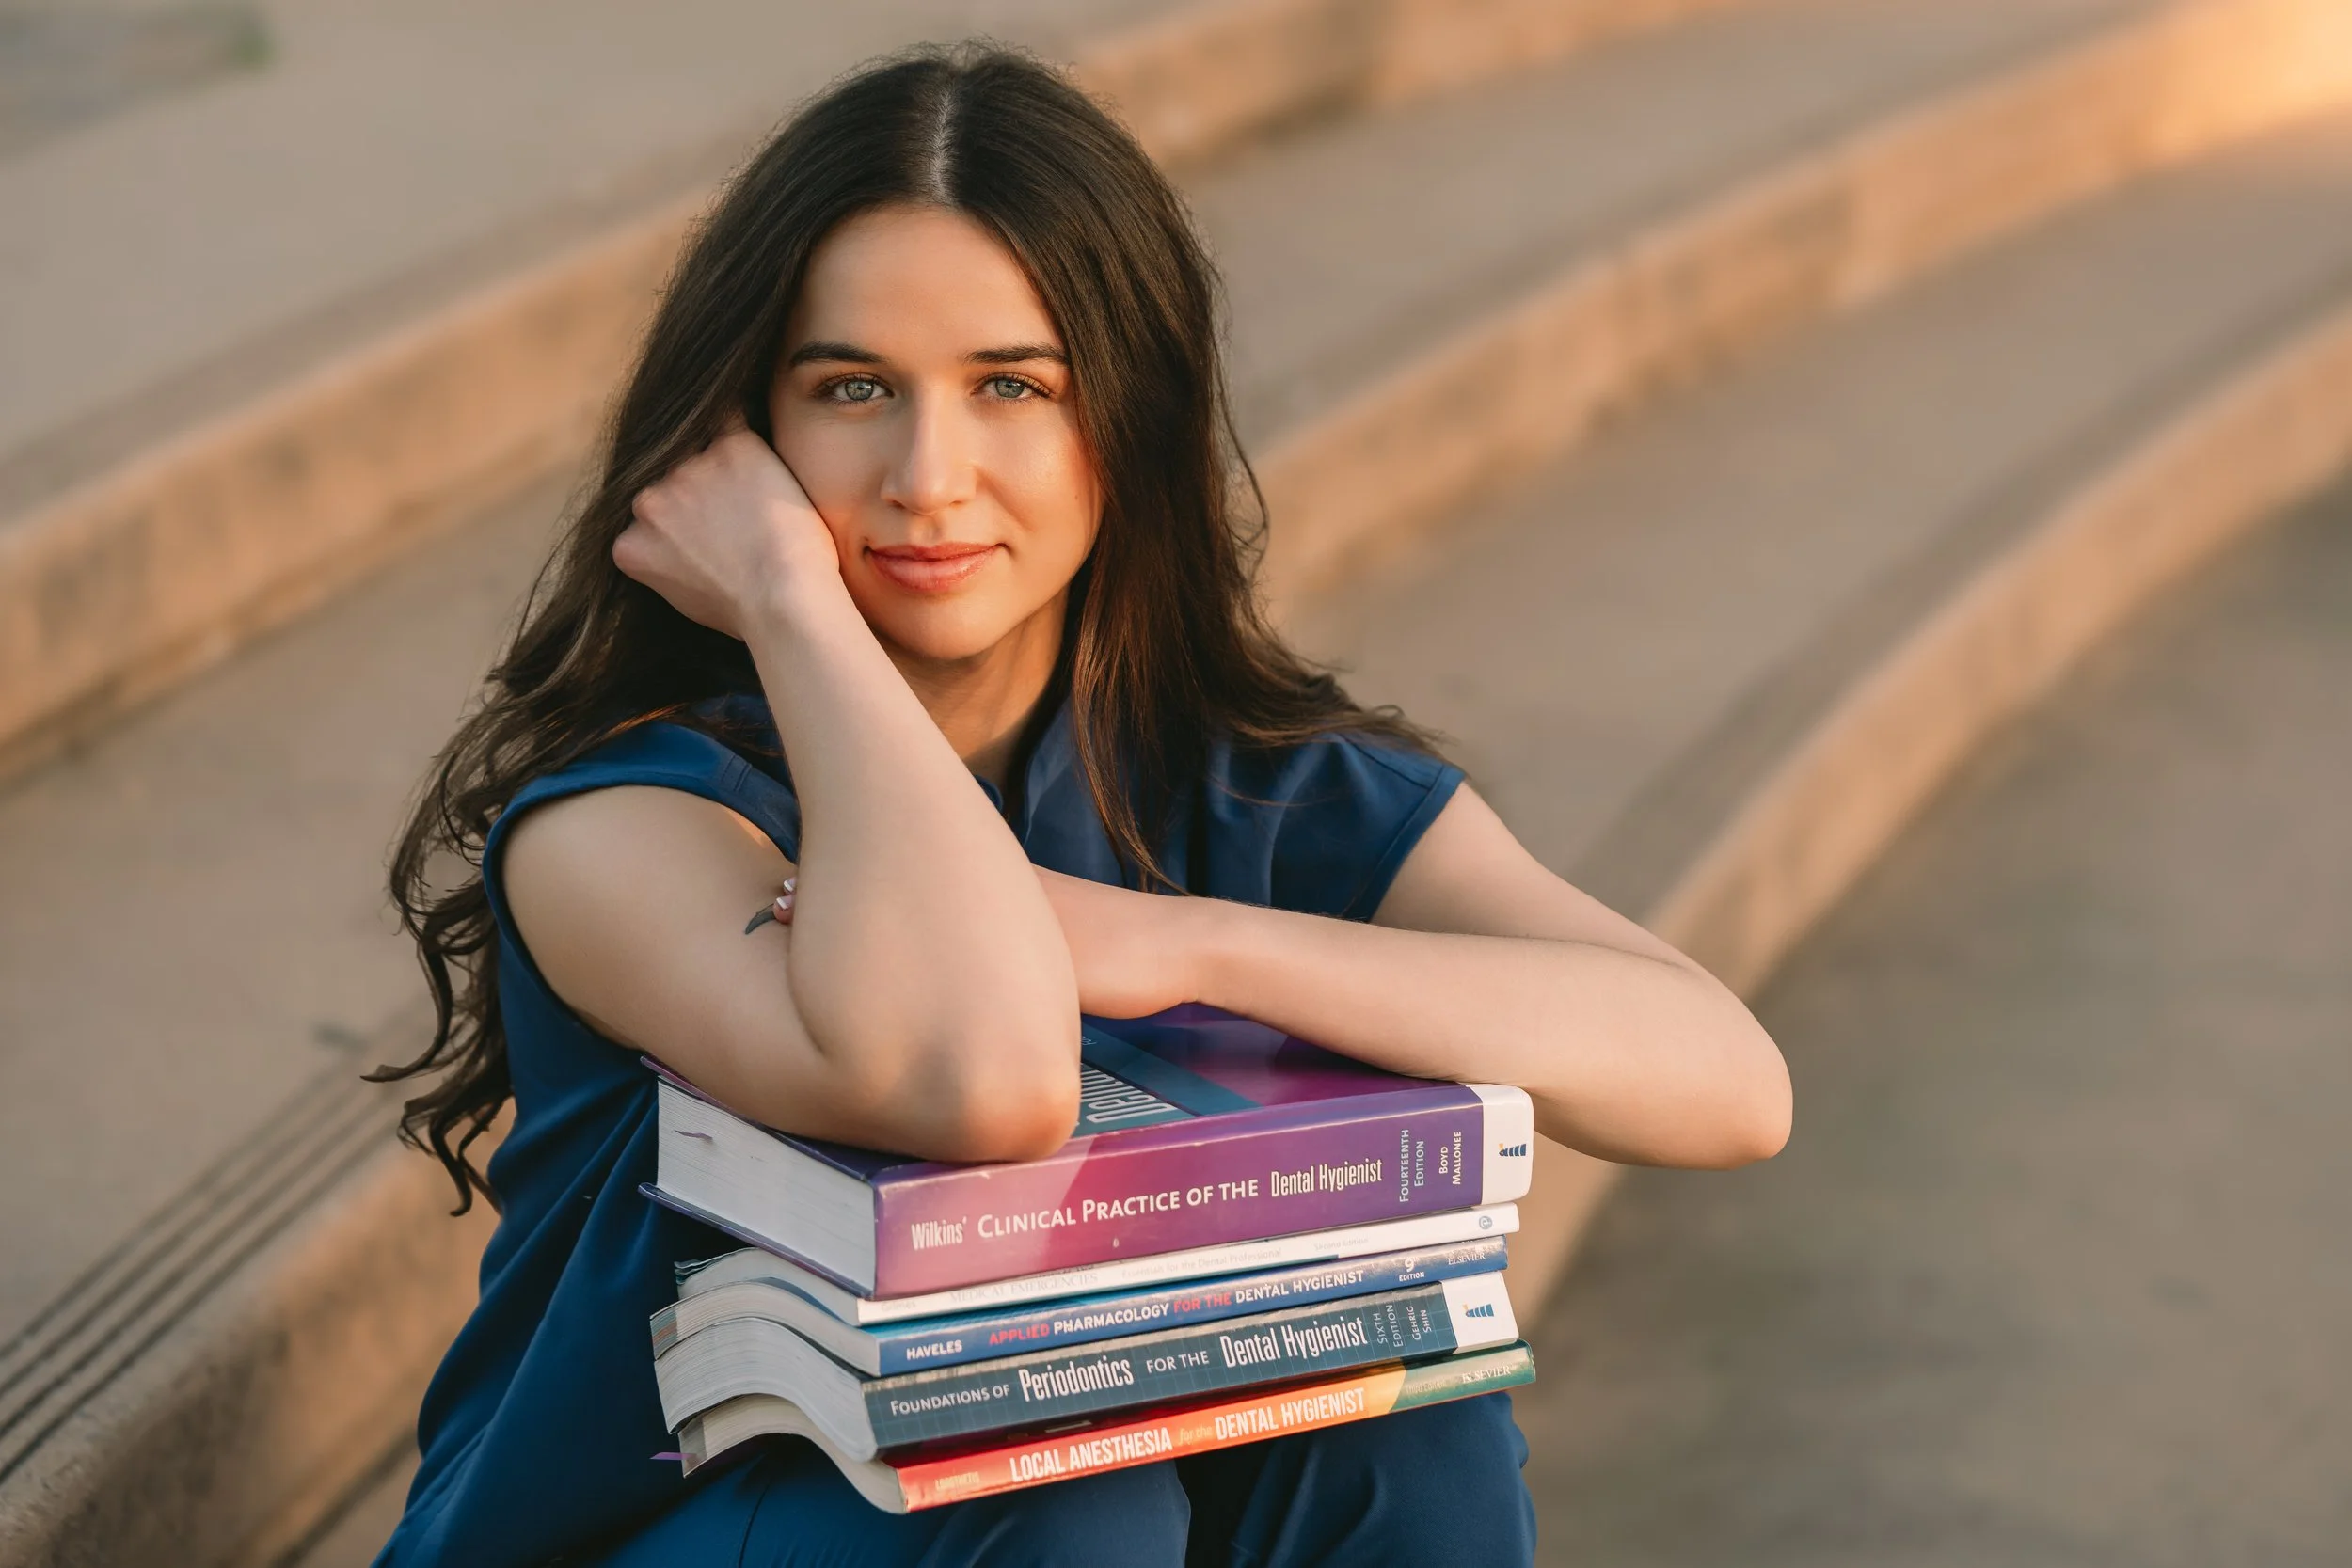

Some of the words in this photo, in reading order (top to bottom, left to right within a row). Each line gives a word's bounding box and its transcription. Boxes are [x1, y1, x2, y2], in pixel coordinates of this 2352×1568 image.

[1399, 1129, 1410, 1203] FOURTEENTH
[1414, 1140, 1425, 1187] EDITION
[1438, 1146, 1449, 1175] BOYD
[1452, 1132, 1463, 1185] MALLONEE
[977, 1207, 1076, 1238] CLINICAL
[1082, 1190, 1181, 1223] PRACTICE
[1186, 1185, 1214, 1207] OF
[1218, 1179, 1259, 1201] THE
[1270, 1165, 1315, 1197] Dental
[1319, 1158, 1383, 1193] Hygienist
[1399, 1271, 1425, 1282] EDITION
[1448, 1252, 1486, 1265] ELSEVIER
[906, 1339, 962, 1360] HAVELES
[989, 1323, 1050, 1345] APPLIED
[1054, 1303, 1169, 1335] PHARMACOLOGY
[1173, 1298, 1200, 1313] FOR
[1204, 1292, 1232, 1307] THE
[1235, 1284, 1289, 1304] DENTAL
[1293, 1269, 1364, 1294] HYGIENIST
[1374, 1312, 1388, 1344] SIXTH
[1386, 1304, 1404, 1347] EDITION
[1406, 1306, 1422, 1340] GEHRIG
[1421, 1309, 1432, 1333] SHIN
[890, 1386, 990, 1416] FOUNDATIONS
[992, 1384, 1010, 1399] OF
[1018, 1353, 1134, 1402] Periodontics
[1146, 1356, 1177, 1374] FOR
[1178, 1351, 1210, 1369] THE
[1219, 1328, 1281, 1369] Dental
[1282, 1316, 1368, 1359] Hygienist
[1009, 1449, 1065, 1483] LOCAL
[1069, 1427, 1173, 1471] ANESTHESIA
[1179, 1427, 1195, 1446] for
[1196, 1424, 1213, 1437] the
[1215, 1401, 1279, 1442] DENTAL
[1280, 1387, 1365, 1427] HYGIENIST
